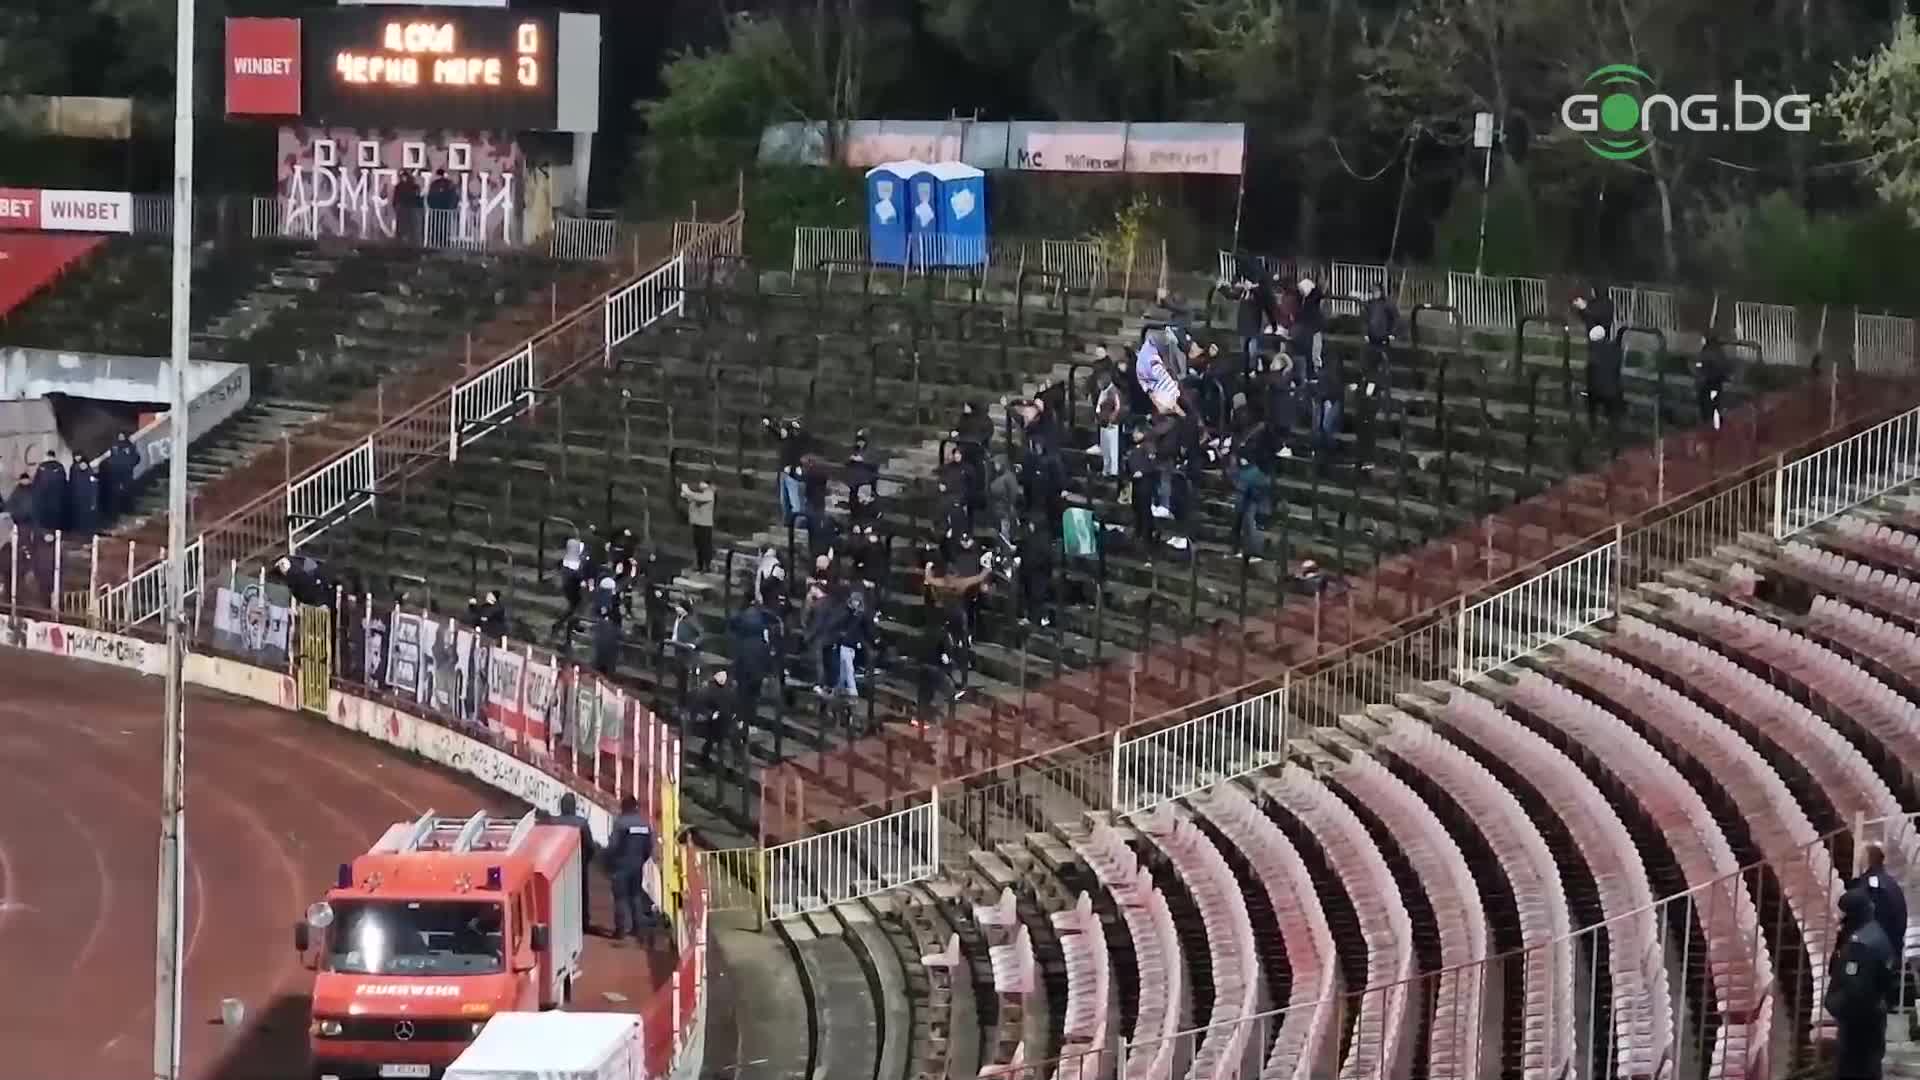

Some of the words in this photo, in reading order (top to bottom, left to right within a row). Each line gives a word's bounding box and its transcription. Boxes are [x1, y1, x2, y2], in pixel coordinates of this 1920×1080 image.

[234, 57, 292, 75] WINBET
[336, 52, 420, 84] ЧЕРНО
[433, 56, 502, 85] МОРЕ
[50, 200, 121, 220] WINBET
[355, 983, 461, 997] FEUERWEHR
